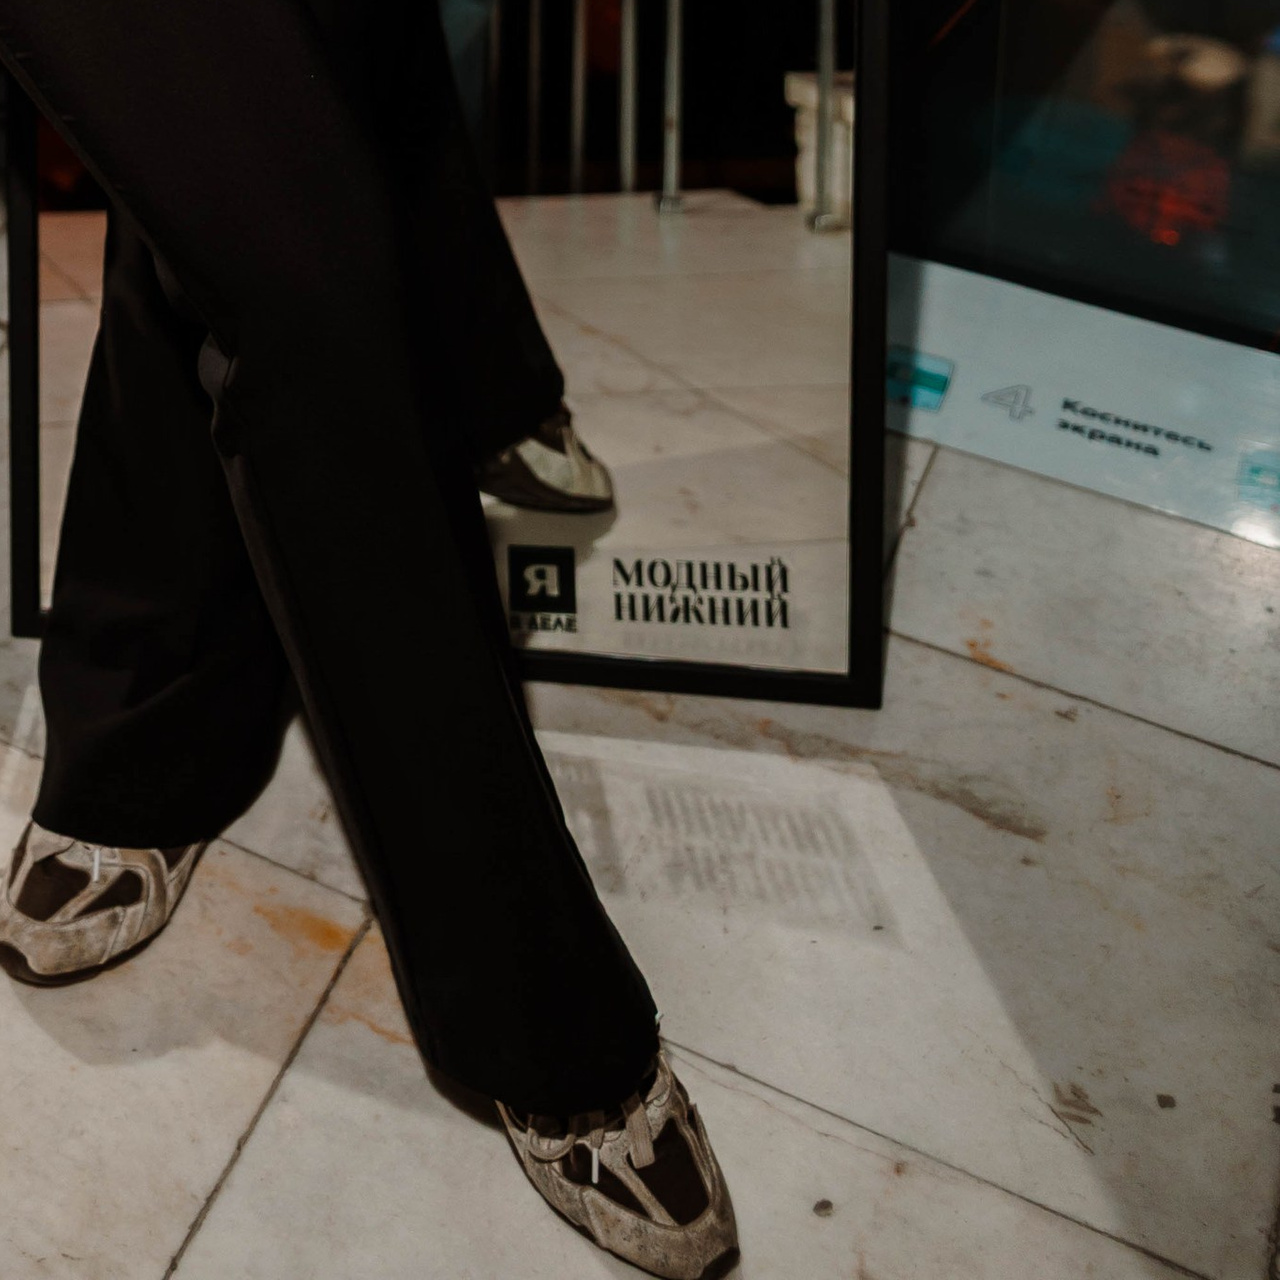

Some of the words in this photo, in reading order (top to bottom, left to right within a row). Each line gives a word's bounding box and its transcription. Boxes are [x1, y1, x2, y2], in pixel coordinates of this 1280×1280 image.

[980, 384, 1035, 421] 4
[1057, 418, 1160, 458] экрана
[1062, 397, 1213, 452] Коснитесь
[523, 564, 560, 597] Я
[612, 556, 789, 593] МОДНЫЙ
[527, 613, 577, 633] ДЕЛЕ
[613, 592, 790, 628] НИЖНИЙ
